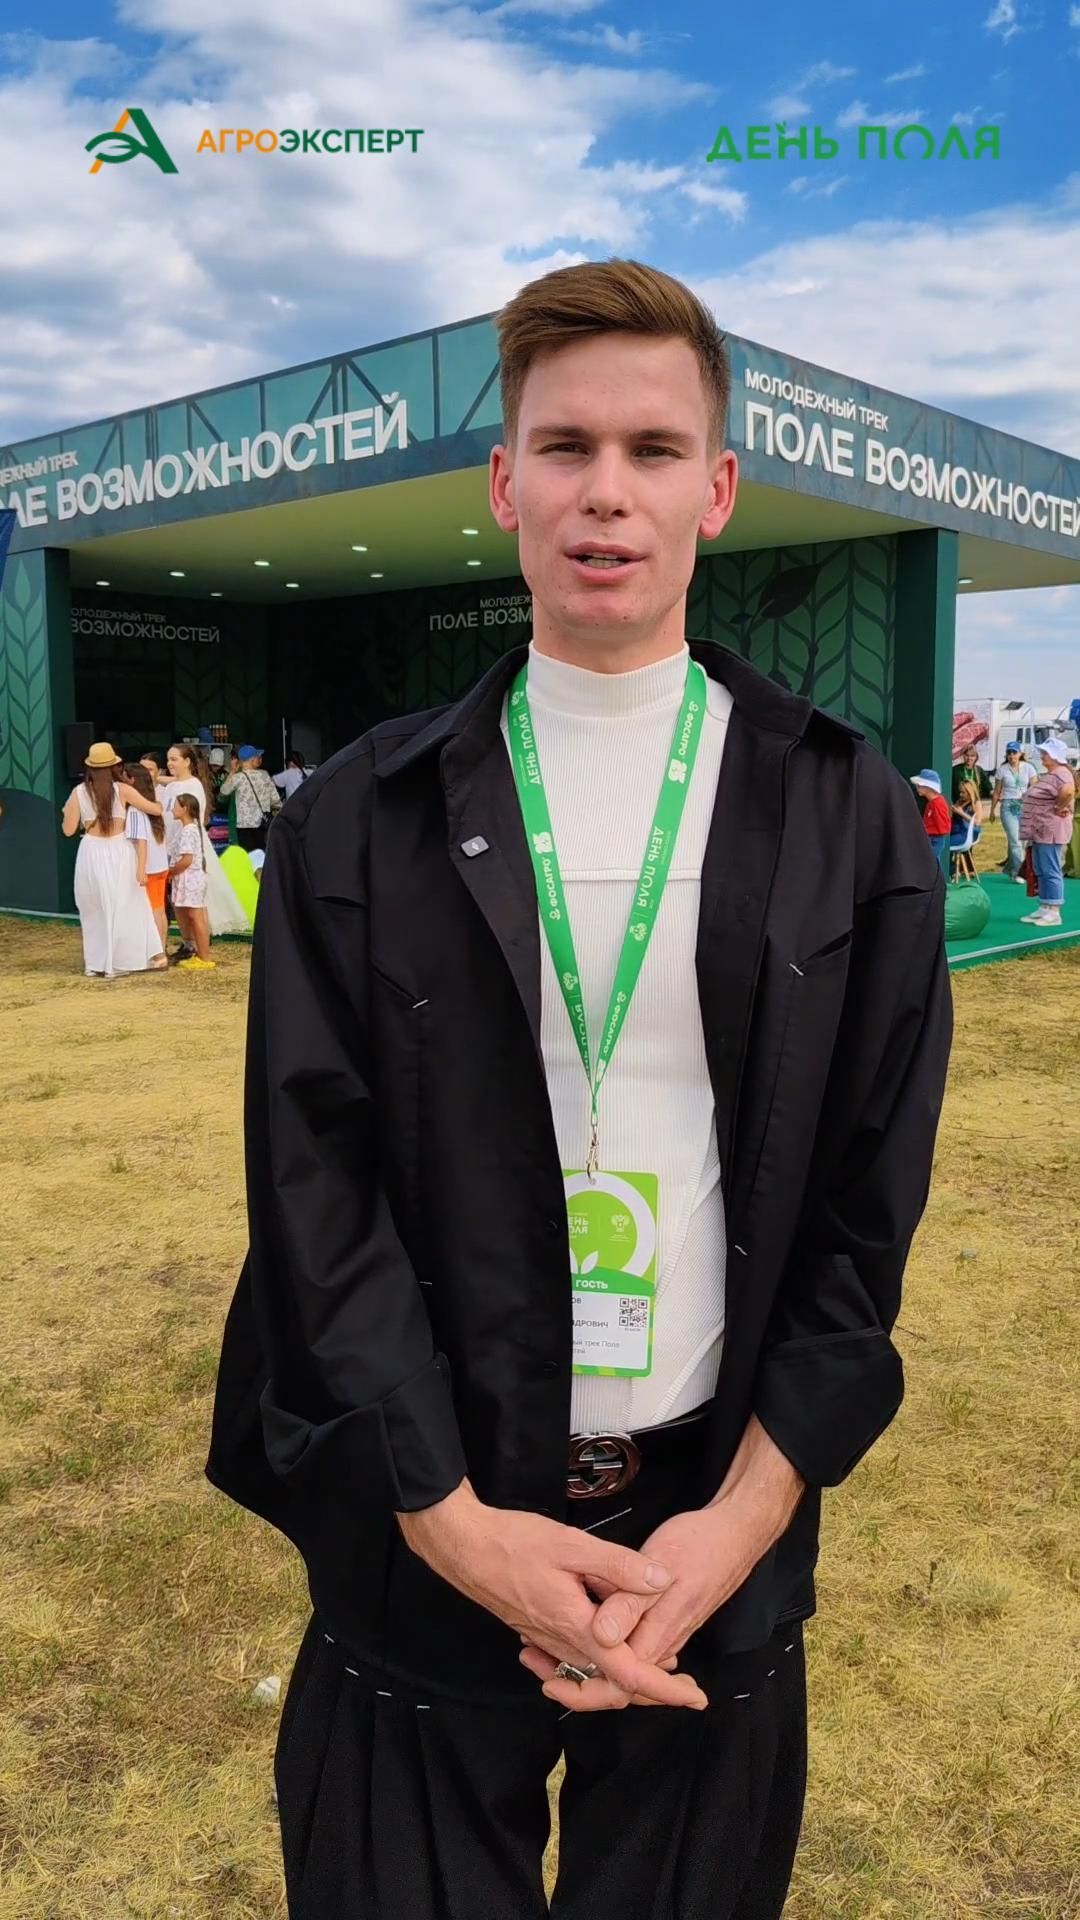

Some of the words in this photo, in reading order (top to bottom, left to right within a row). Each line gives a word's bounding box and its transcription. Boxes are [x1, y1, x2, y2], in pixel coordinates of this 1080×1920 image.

[745, 367, 857, 420] МОЛОДЕЖНЫЙ
[858, 405, 889, 432] ТРЕК
[0, 485, 48, 528] ЛЕ
[57, 391, 408, 521] ВОЗМОЖНОСТЕЙ
[745, 400, 855, 478] ПОЛЕ
[48, 450, 79, 473] ТРЕК
[142, 613, 167, 624] ТРЕК
[429, 611, 479, 631] ПОЛЕ
[518, 712, 534, 749] ПОЛЯ
[678, 712, 694, 756] ФОСАГРО
[525, 751, 542, 785] ДЕНЬ
[647, 825, 665, 862] ДЕНЬ
[542, 857, 558, 907] ФОСАГРО
[636, 865, 656, 908] ПОЛЯ
[603, 1004, 620, 1053] ФОСАГРО
